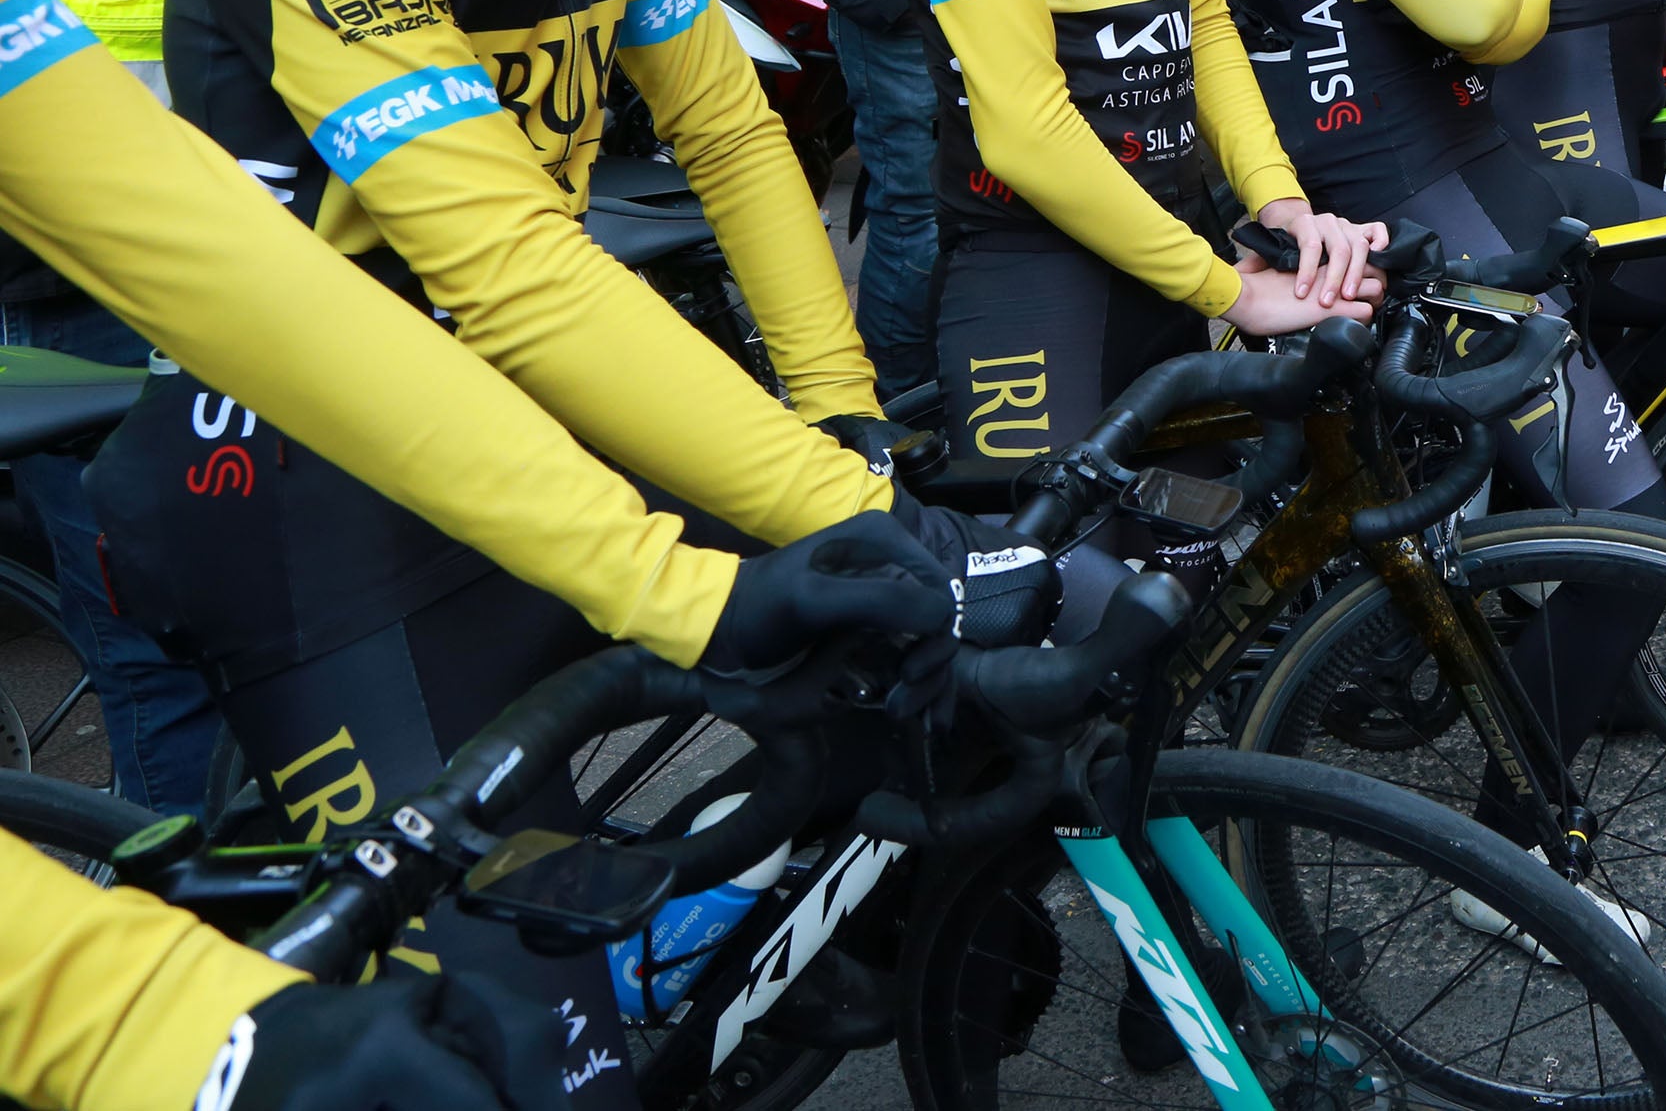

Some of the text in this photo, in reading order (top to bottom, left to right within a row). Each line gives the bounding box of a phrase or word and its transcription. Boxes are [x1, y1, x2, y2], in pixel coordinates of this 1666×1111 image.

[0, 4, 63, 62] GK
[355, 84, 432, 140] EGK
[1604, 418, 1642, 464] Spiuk
[1054, 827, 1070, 837] MEN
[672, 905, 704, 939] europa
